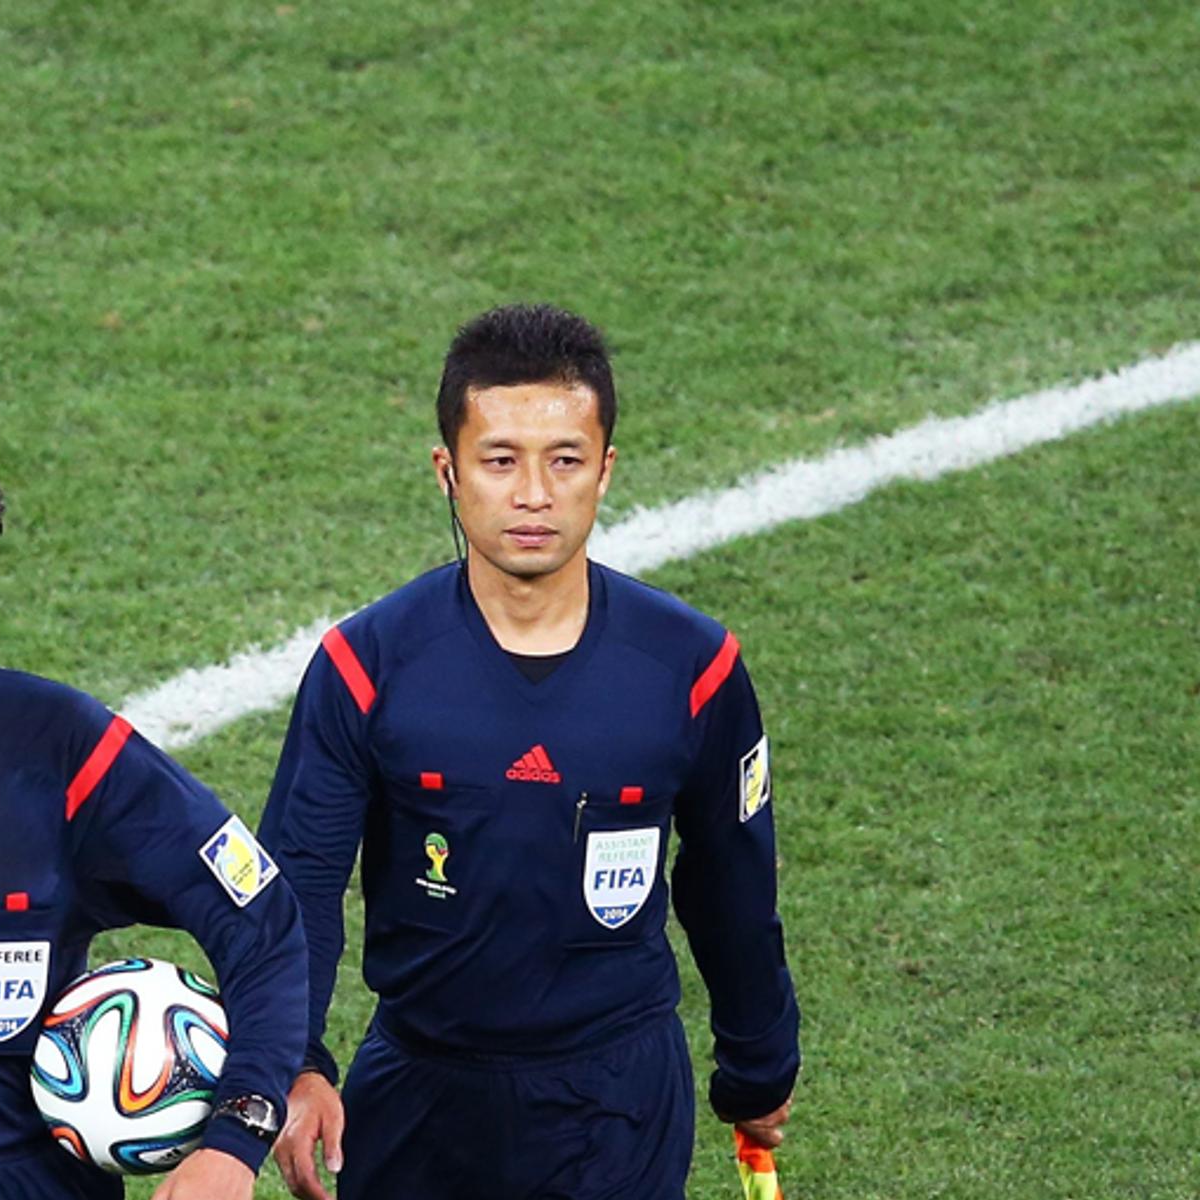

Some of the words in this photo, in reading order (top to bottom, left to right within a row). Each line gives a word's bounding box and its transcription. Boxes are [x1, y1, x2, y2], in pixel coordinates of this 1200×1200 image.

[505, 767, 561, 784] adidas
[595, 836, 654, 850] ASSISTANT
[599, 849, 647, 861] REFEREE
[594, 867, 645, 890] FIFA
